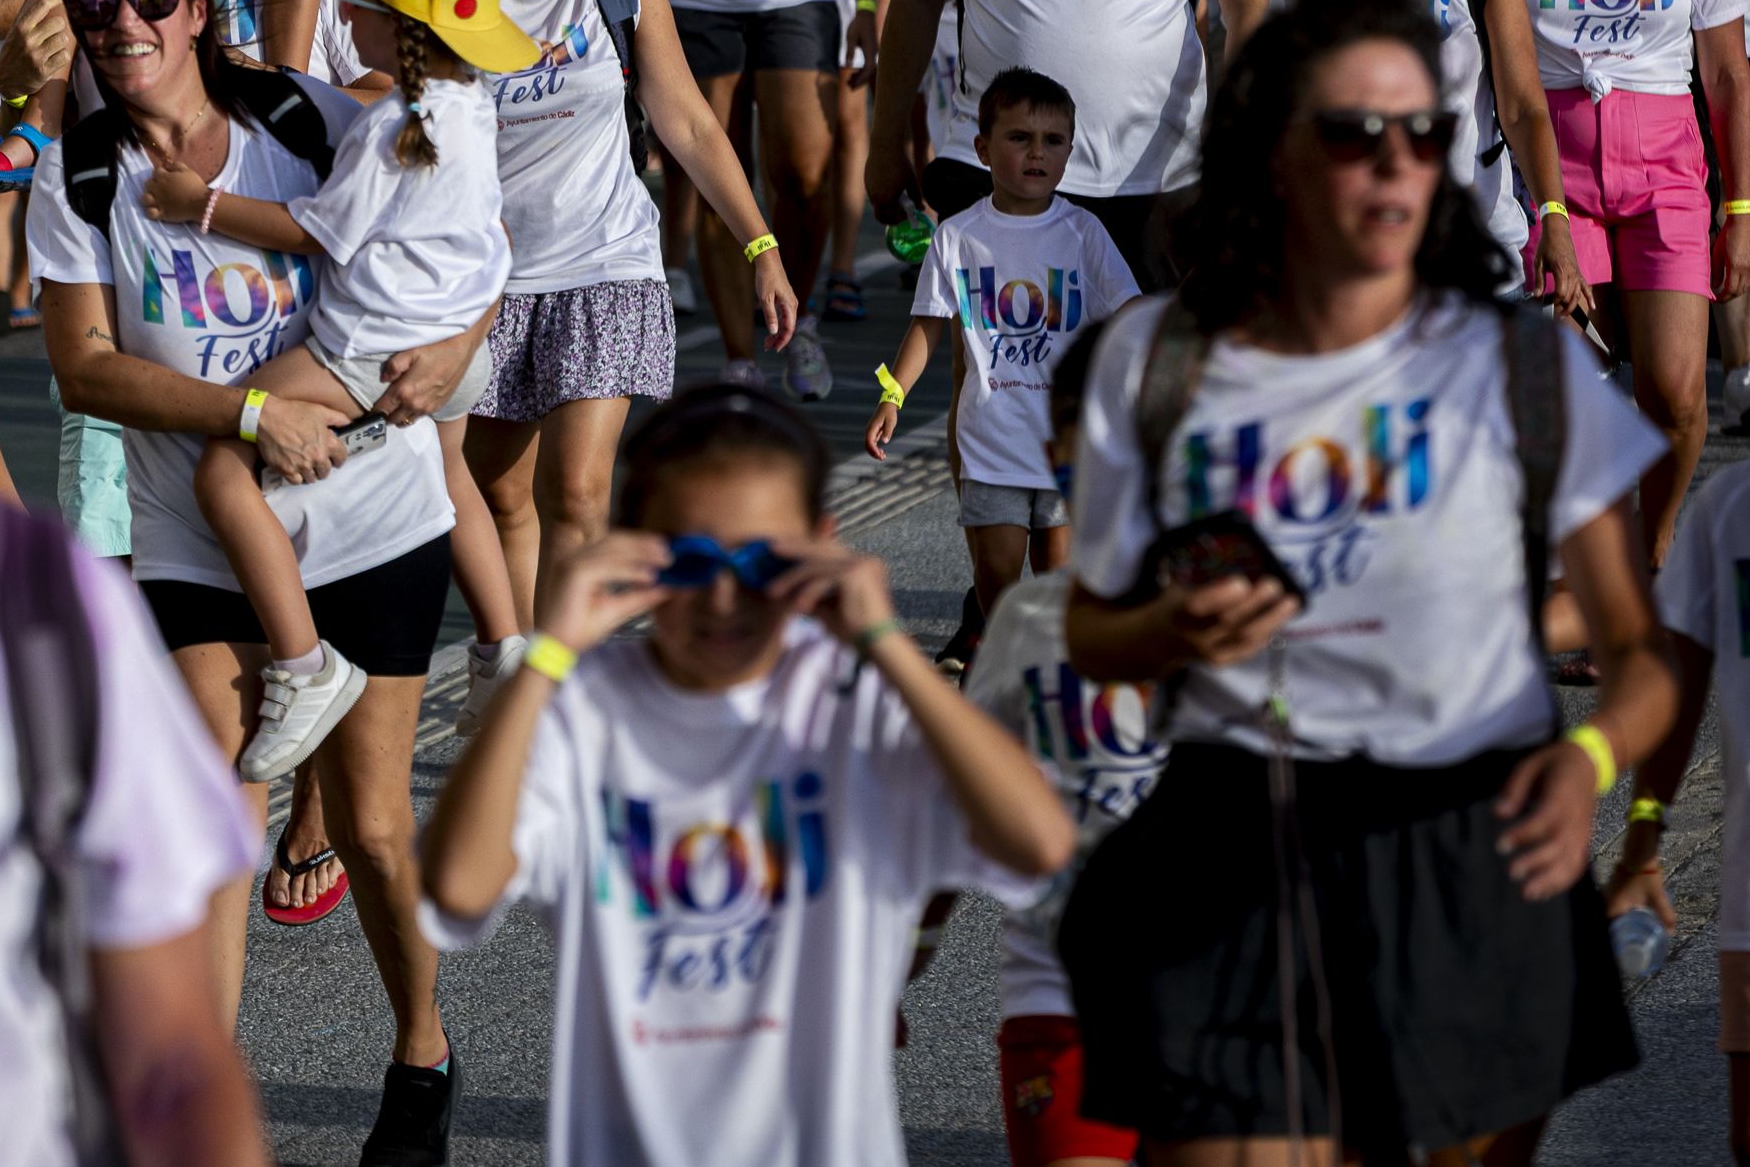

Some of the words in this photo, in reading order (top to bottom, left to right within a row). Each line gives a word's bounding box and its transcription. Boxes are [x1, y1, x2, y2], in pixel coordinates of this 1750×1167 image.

[1572, 12, 1646, 44] Fest
[492, 65, 568, 113] Fest
[506, 114, 548, 127] Ayuntamiento
[956, 267, 1083, 333] Holi
[194, 325, 288, 378] Fest
[990, 330, 1054, 370] Fest
[1184, 398, 1431, 524] Holi
[595, 773, 827, 918] Holi
